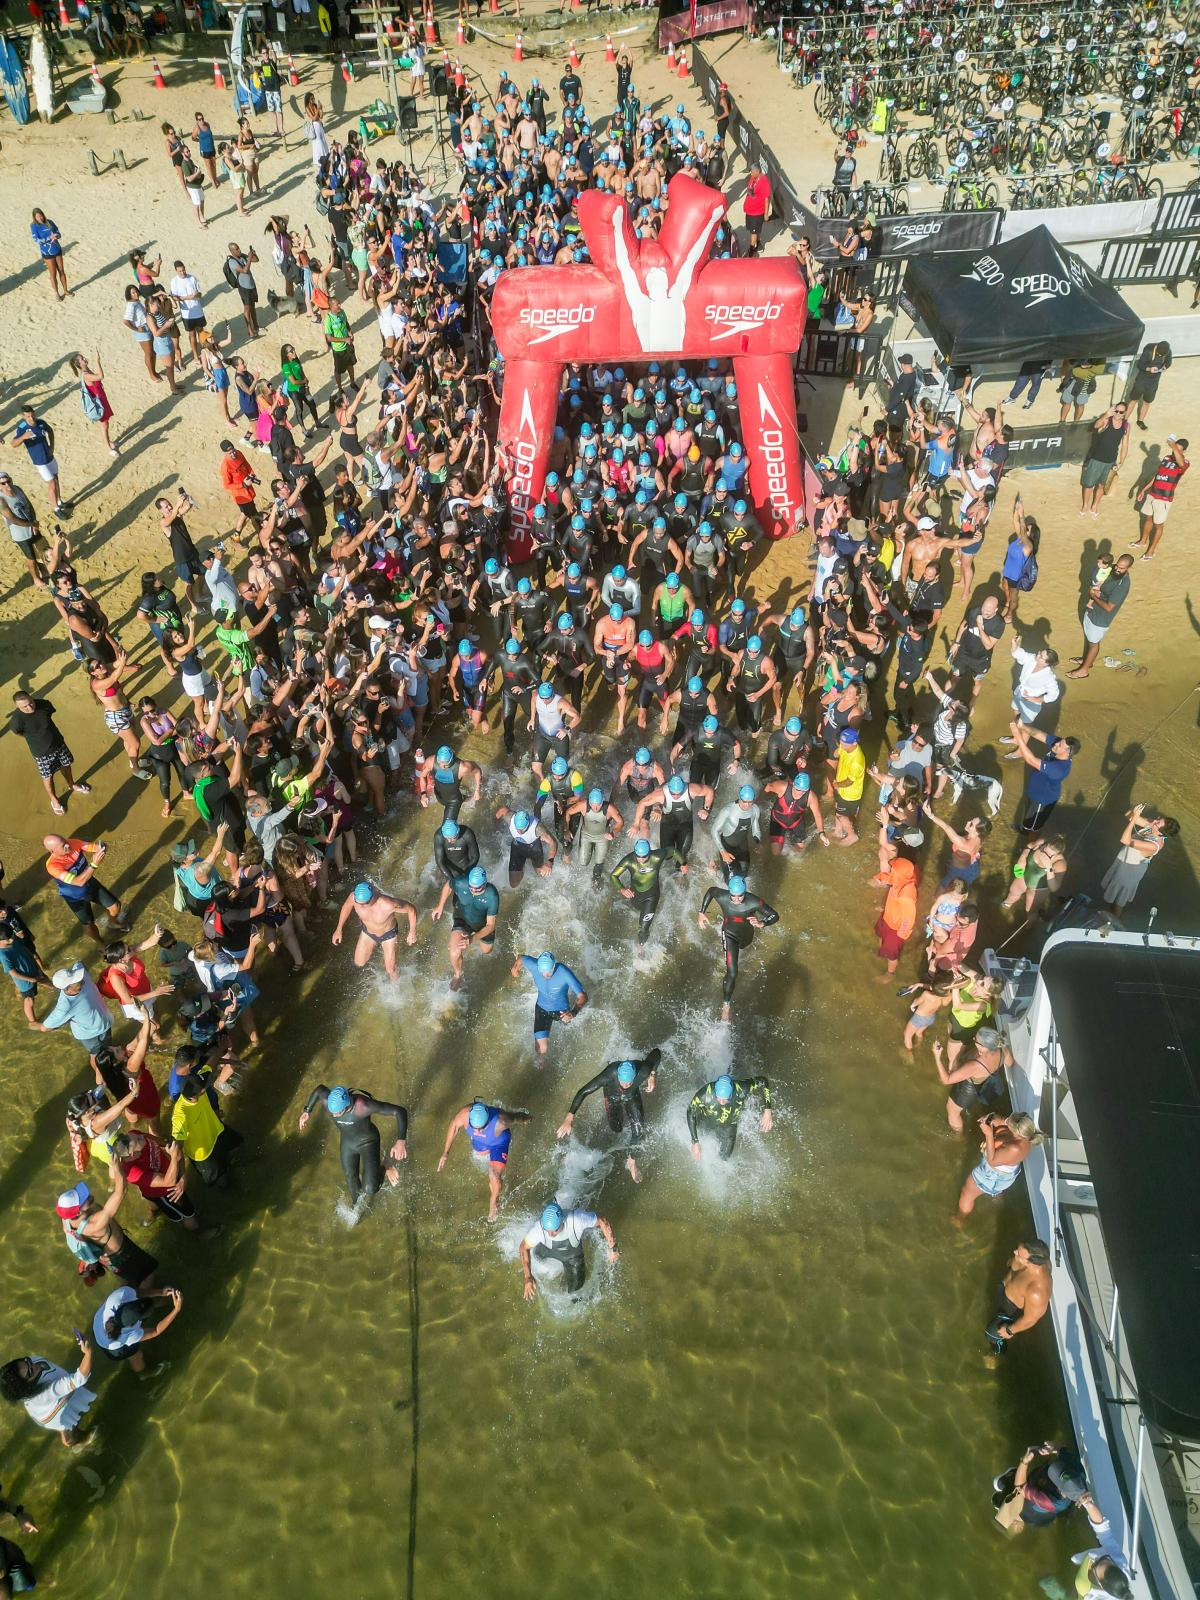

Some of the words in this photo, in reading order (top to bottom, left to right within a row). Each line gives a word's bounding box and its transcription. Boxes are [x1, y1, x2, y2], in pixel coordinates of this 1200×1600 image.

[890, 220, 942, 239] speedo
[1010, 273, 1071, 296] SPEEDO
[519, 303, 596, 329] speedo
[704, 301, 782, 325] speedo
[758, 429, 795, 520] speedo
[508, 441, 537, 543] speedo
